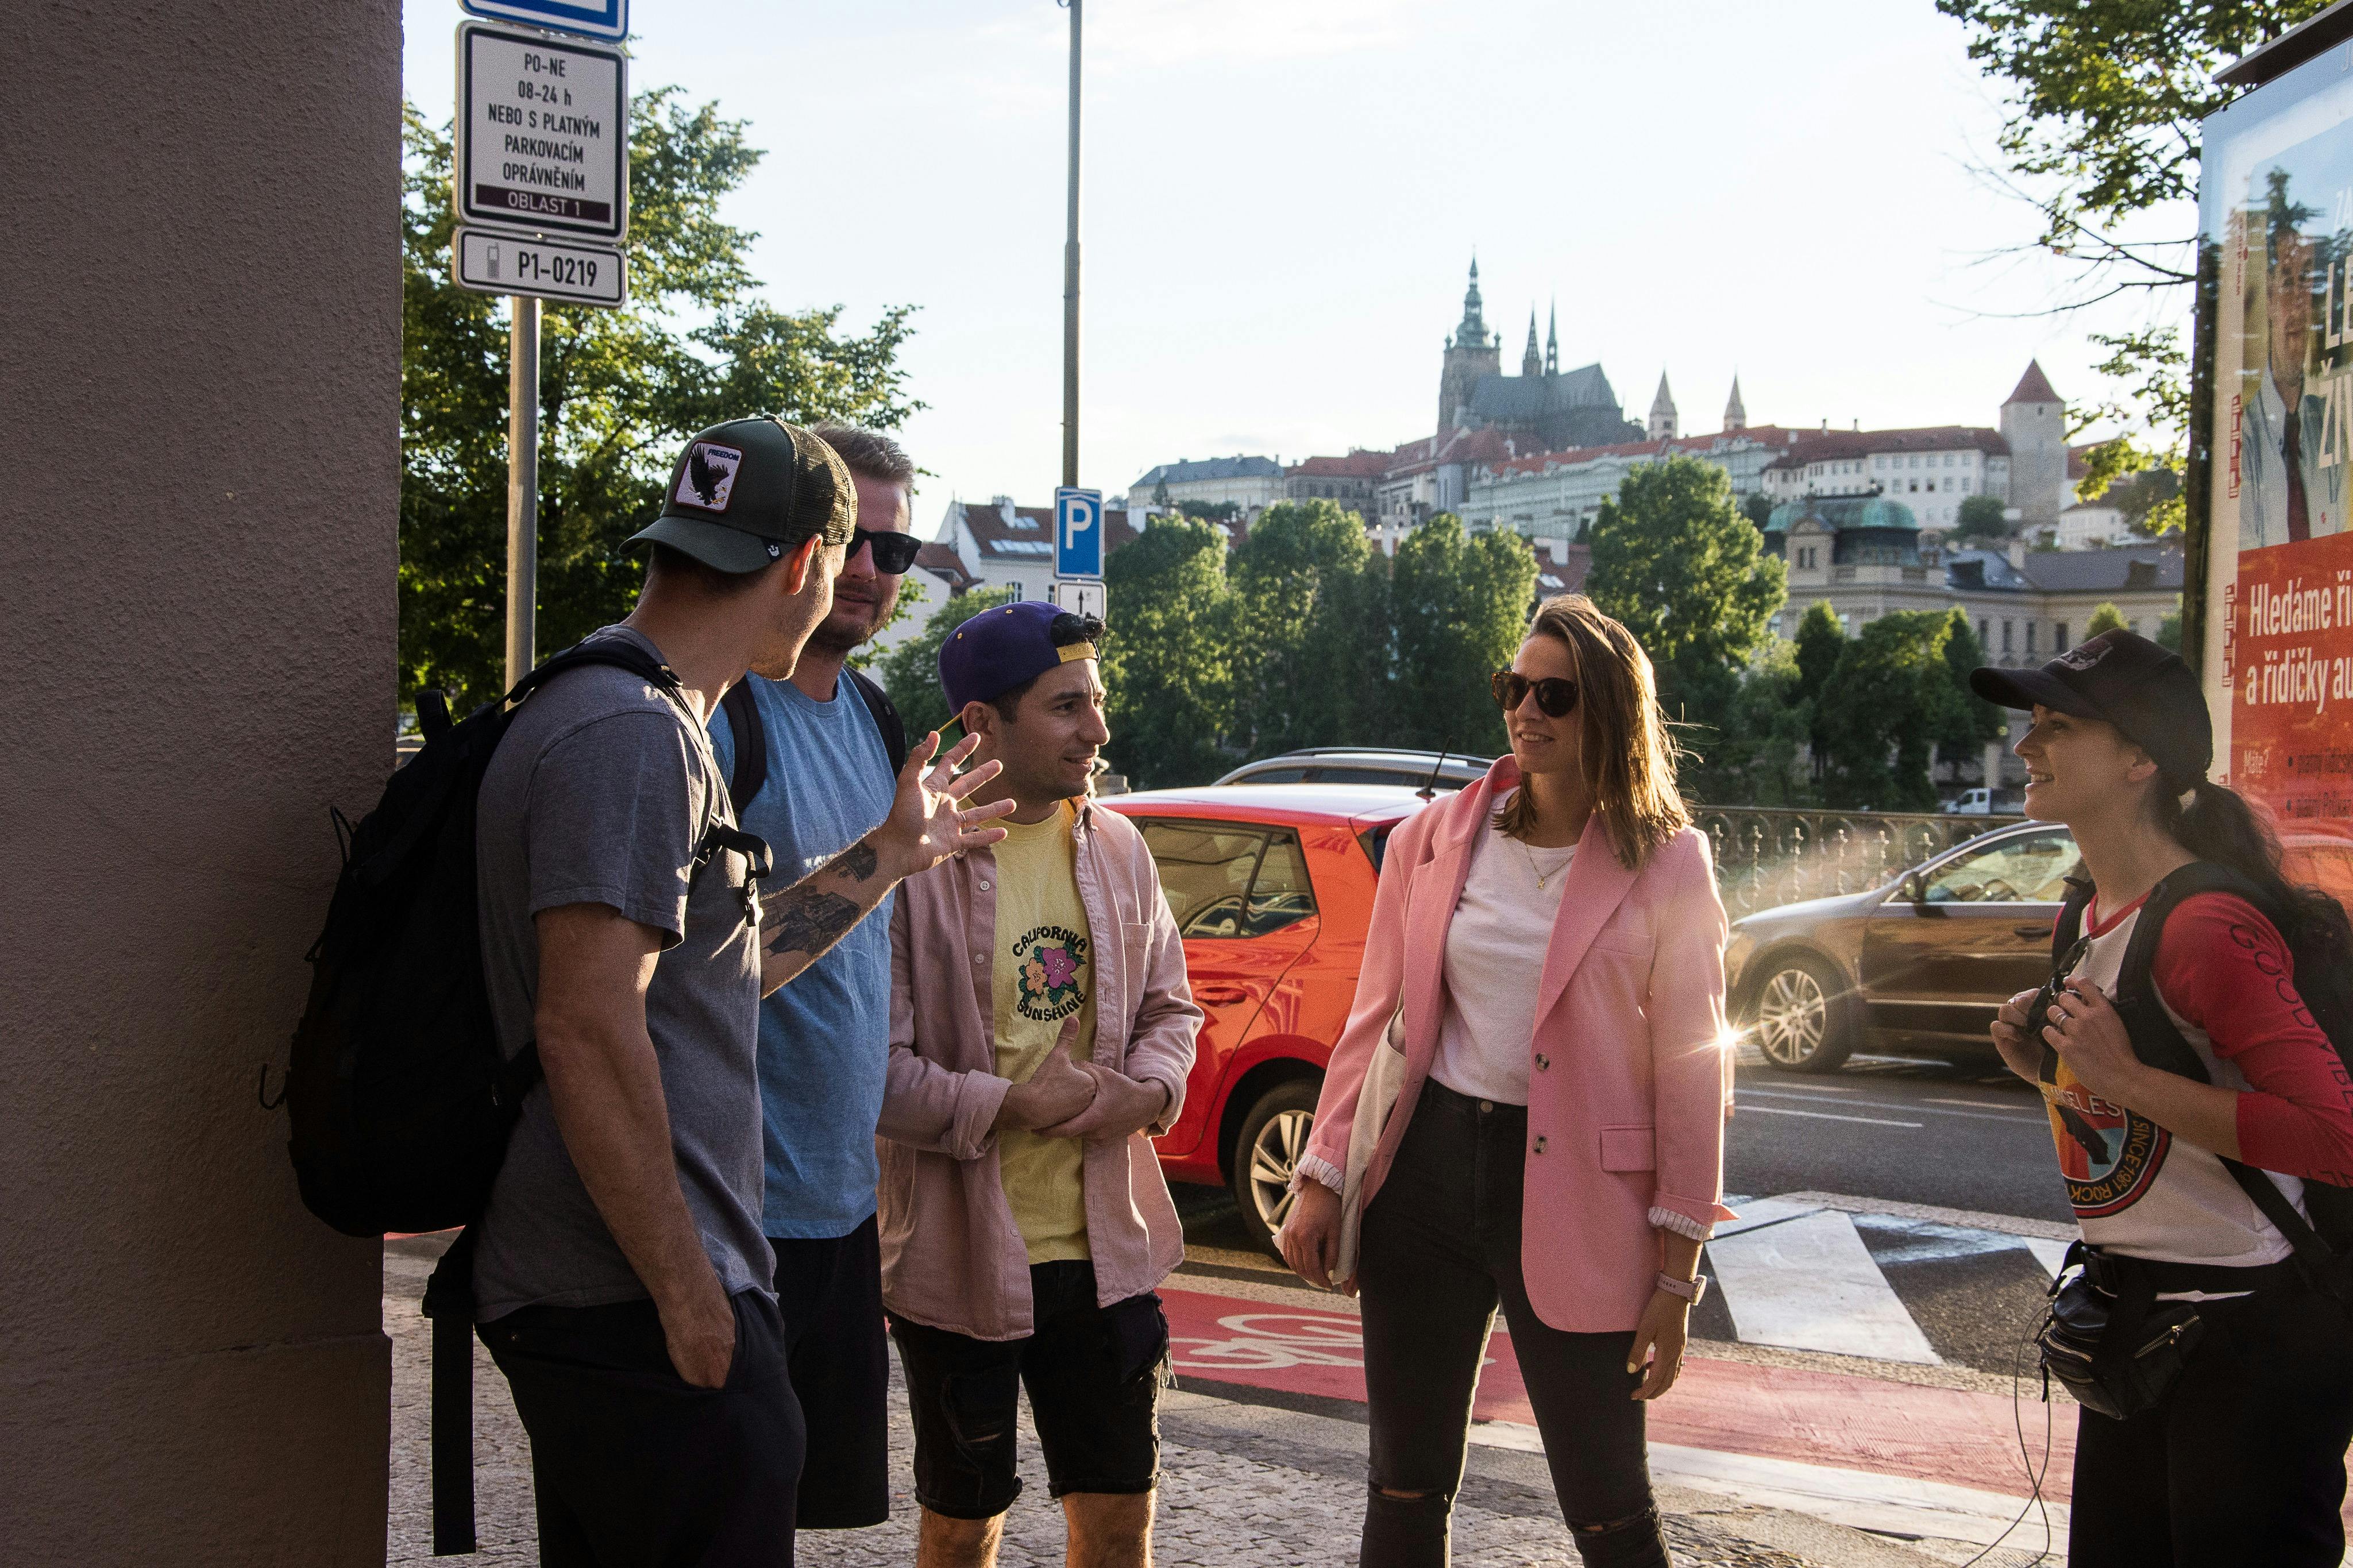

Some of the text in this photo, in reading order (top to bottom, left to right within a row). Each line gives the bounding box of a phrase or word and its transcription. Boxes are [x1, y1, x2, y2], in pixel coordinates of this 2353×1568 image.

[524, 53, 566, 78] PO-NE
[518, 82, 572, 106] 08-24 h
[488, 103, 600, 139] NEBO S PLATNÝM
[504, 134, 584, 164] PARKOVACÍM
[503, 161, 585, 191] OPRÁVNĚNÍM
[508, 192, 581, 217] OBLAST 1
[518, 250, 597, 287] P1-0219
[707, 448, 740, 461] FREEDOM
[1066, 500, 1093, 550] P
[2249, 569, 2353, 637] Hledáme ři
[2245, 665, 2258, 706] a
[2262, 646, 2329, 715] řidičky
[1012, 925, 1088, 957] CALIFORNIA
[1017, 990, 1087, 1022] SUNSHINE
[2124, 1120, 2150, 1169] SINCE
[2070, 1183, 2113, 1202] ROCK
